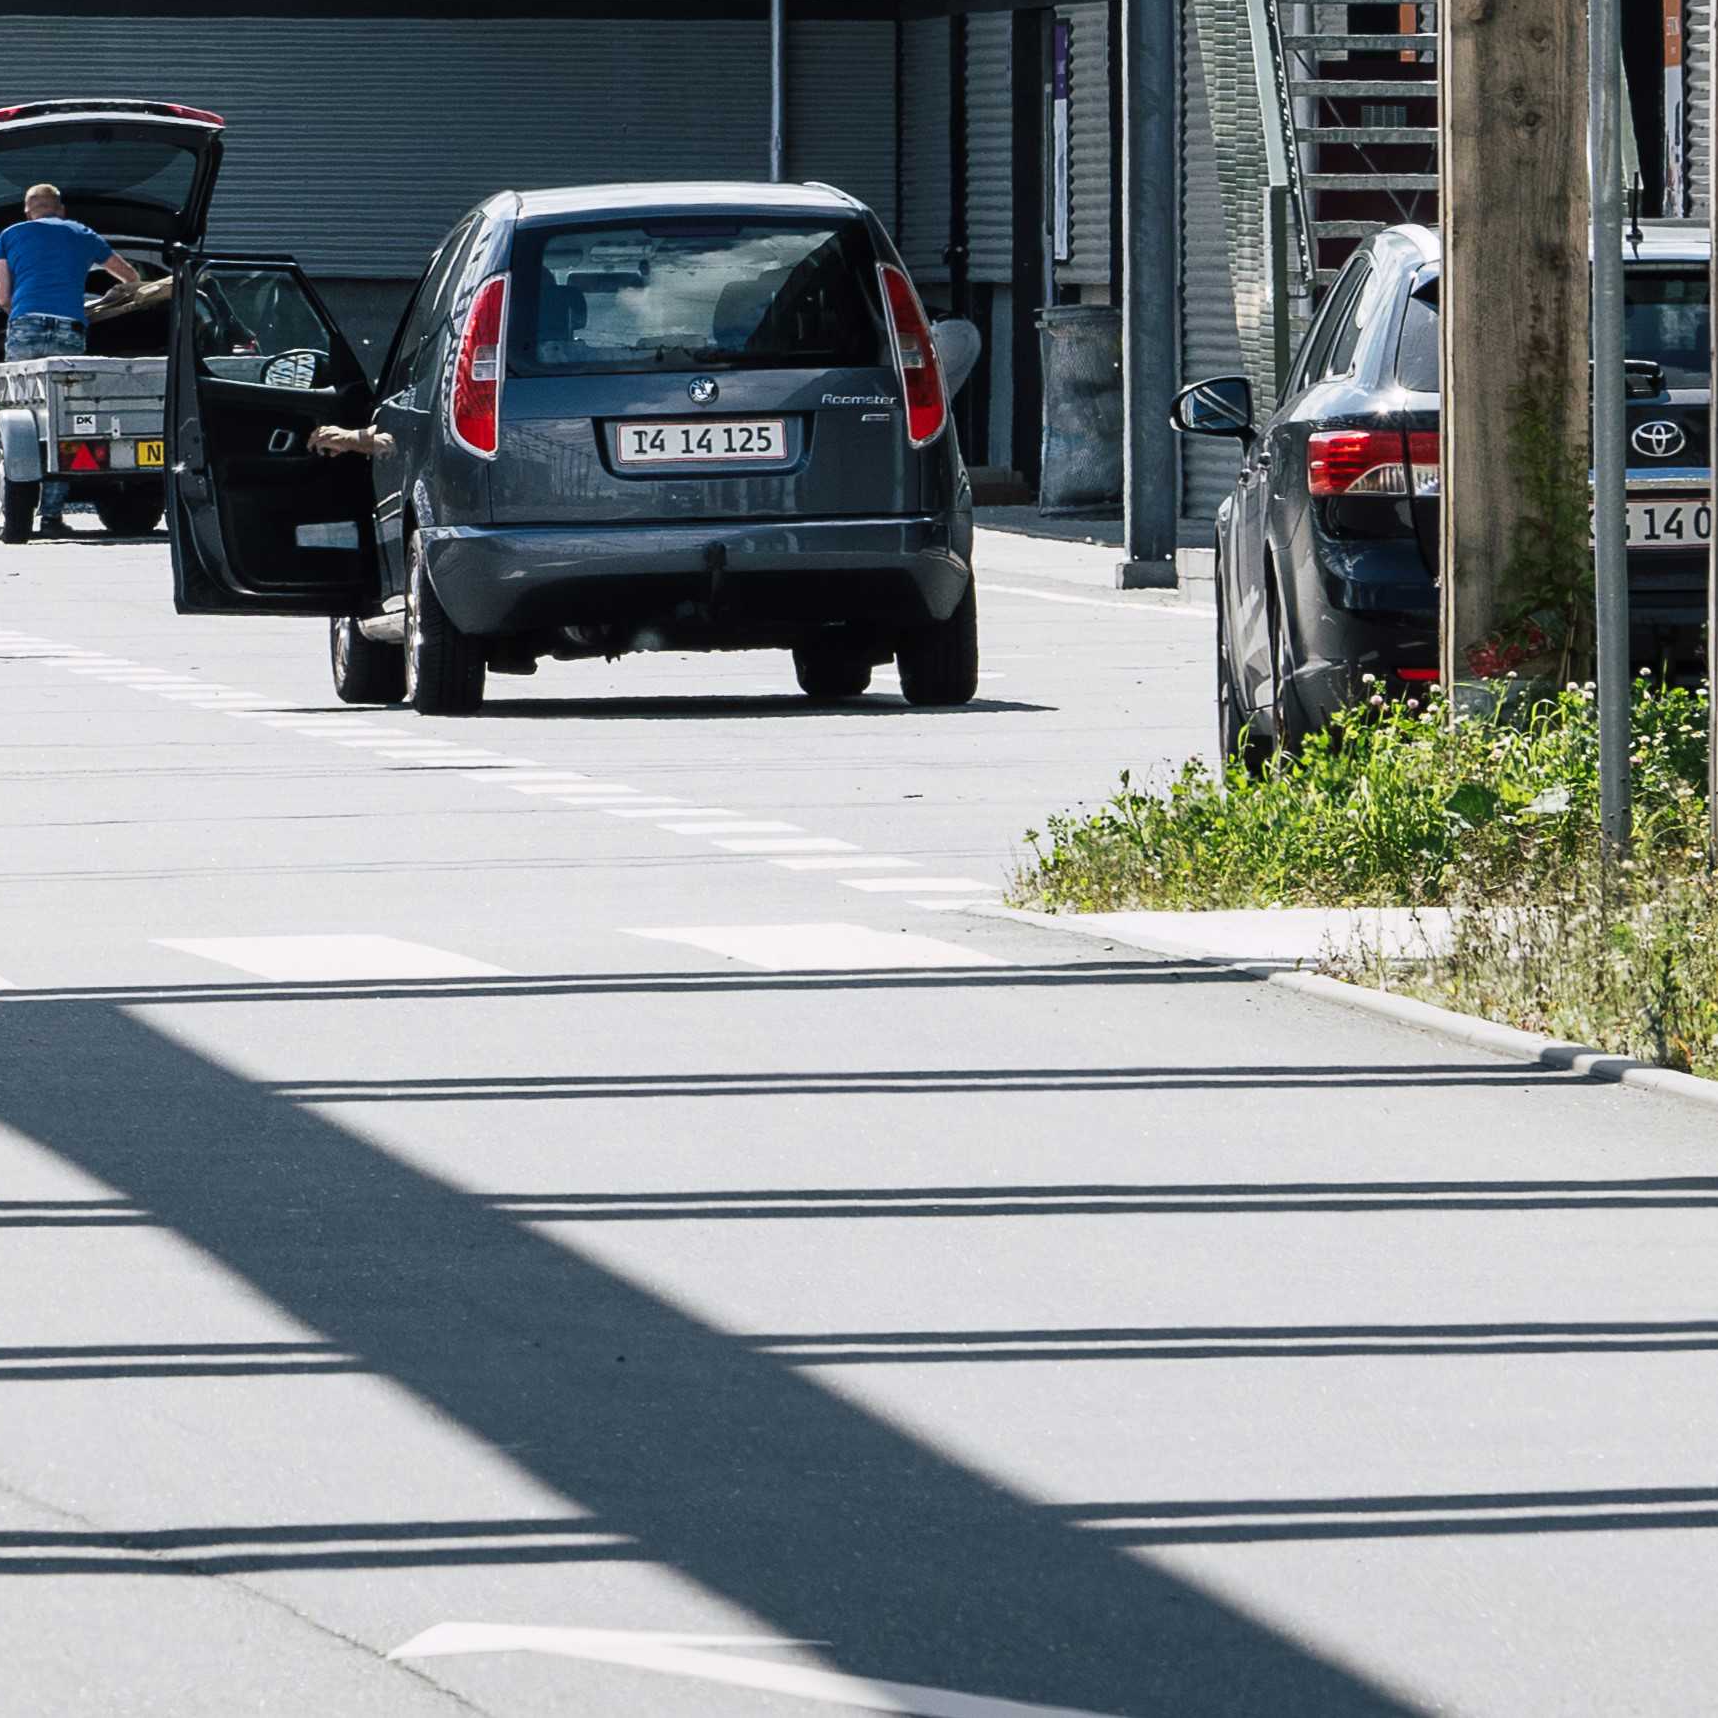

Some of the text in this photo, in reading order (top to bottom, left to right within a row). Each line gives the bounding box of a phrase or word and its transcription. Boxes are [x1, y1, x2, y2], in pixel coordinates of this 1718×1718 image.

[821, 393, 898, 405] Roomster
[76, 416, 93, 425] DK
[680, 428, 713, 454] 14
[722, 426, 773, 453] 125
[1643, 507, 1684, 540] 14
